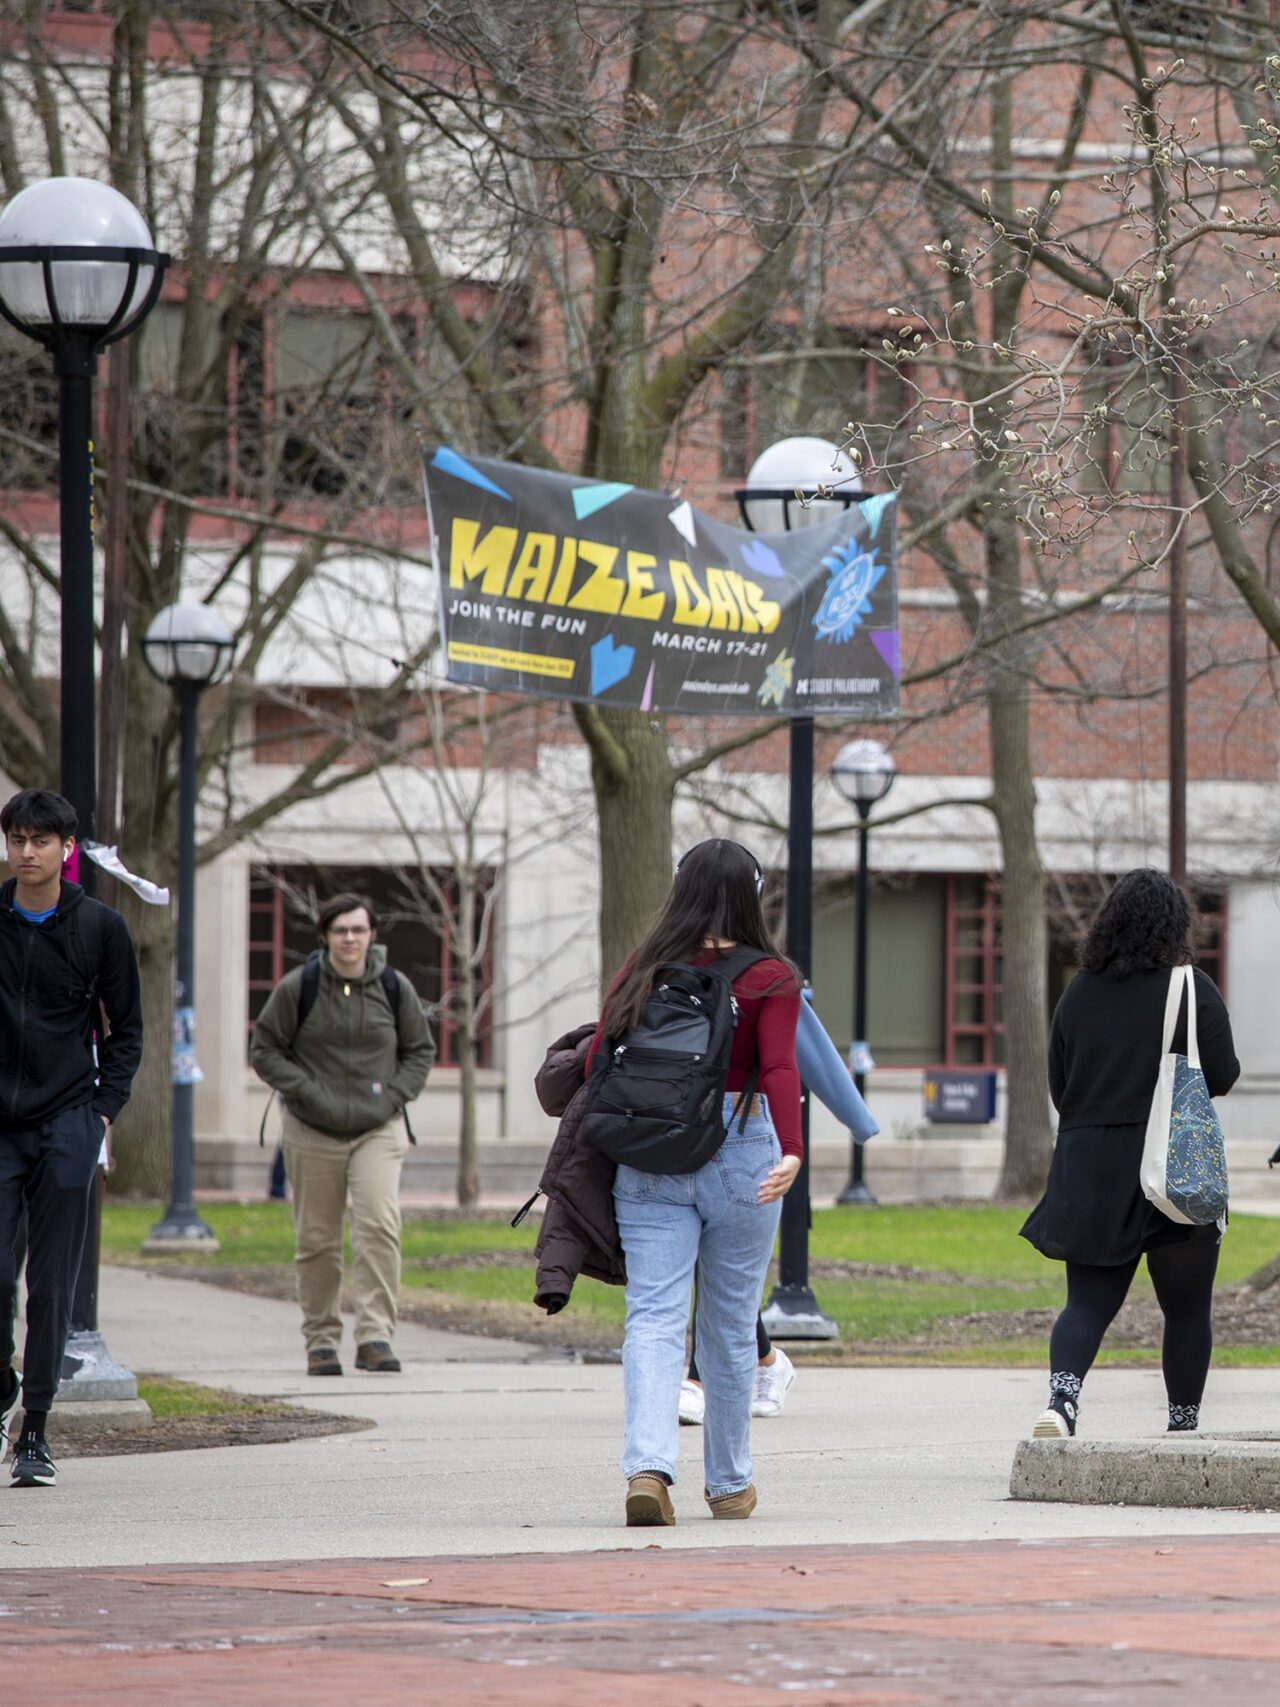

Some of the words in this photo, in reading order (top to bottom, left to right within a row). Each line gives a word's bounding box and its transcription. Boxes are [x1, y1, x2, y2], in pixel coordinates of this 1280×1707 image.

[450, 517, 666, 621] MAIZE
[449, 599, 491, 620] JOIN
[495, 606, 536, 628] THE
[540, 613, 587, 635] FUN
[652, 631, 722, 654] MARCH
[726, 641, 768, 656] 17-21
